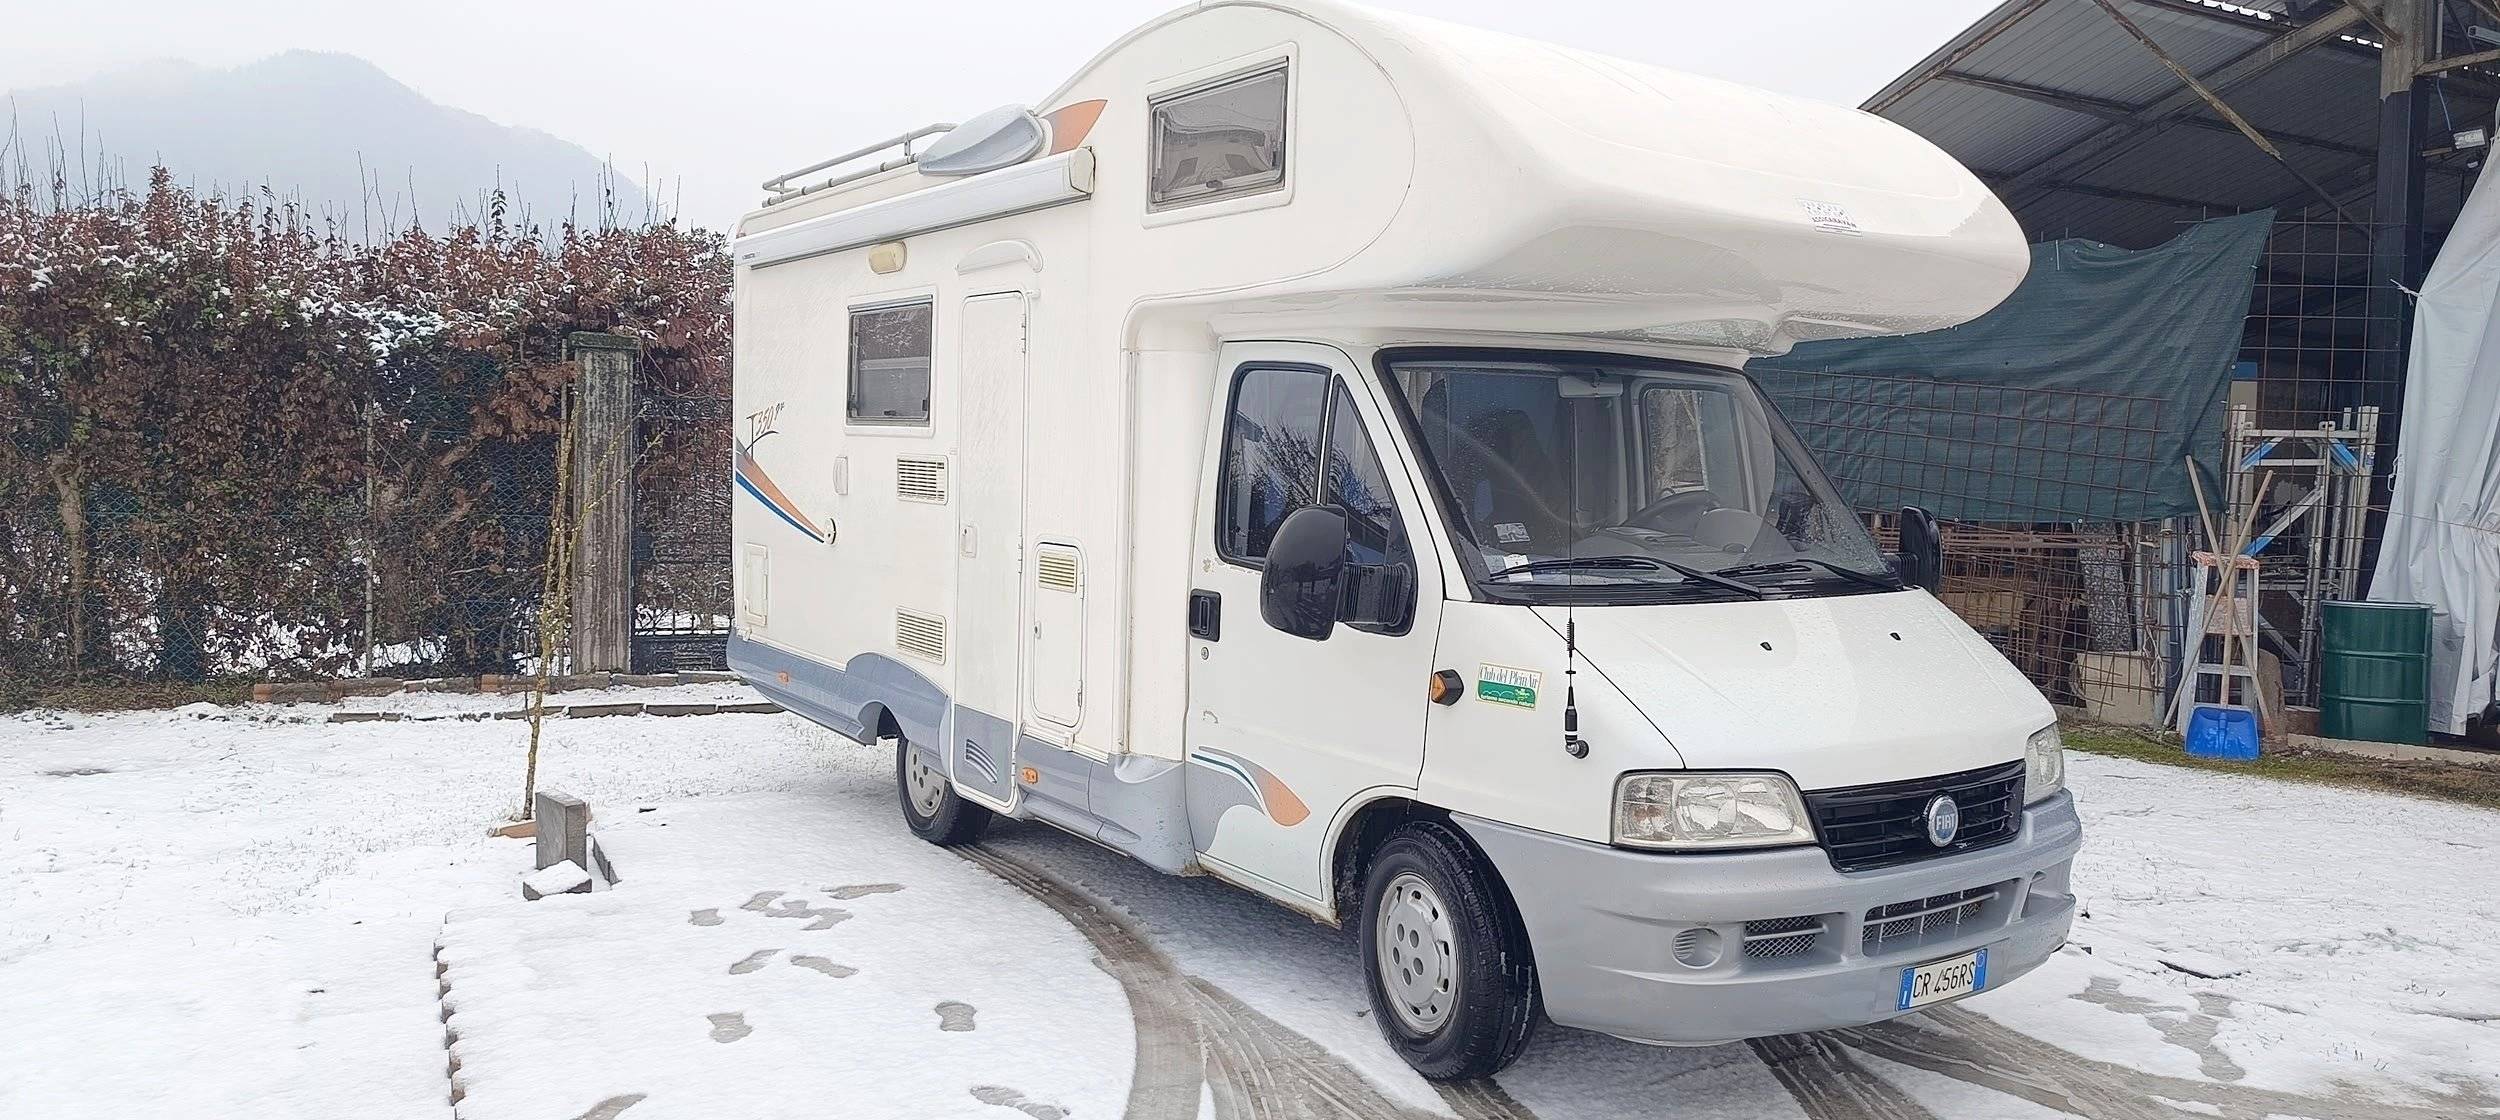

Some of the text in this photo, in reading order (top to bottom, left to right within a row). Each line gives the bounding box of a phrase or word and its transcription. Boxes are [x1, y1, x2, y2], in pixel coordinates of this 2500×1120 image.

[1480, 665, 1495, 681] Club
[1496, 668, 1508, 684] del
[1935, 813, 1956, 831] FIAT
[1913, 972, 1931, 998] CR
[1933, 960, 1976, 994] 456RS
